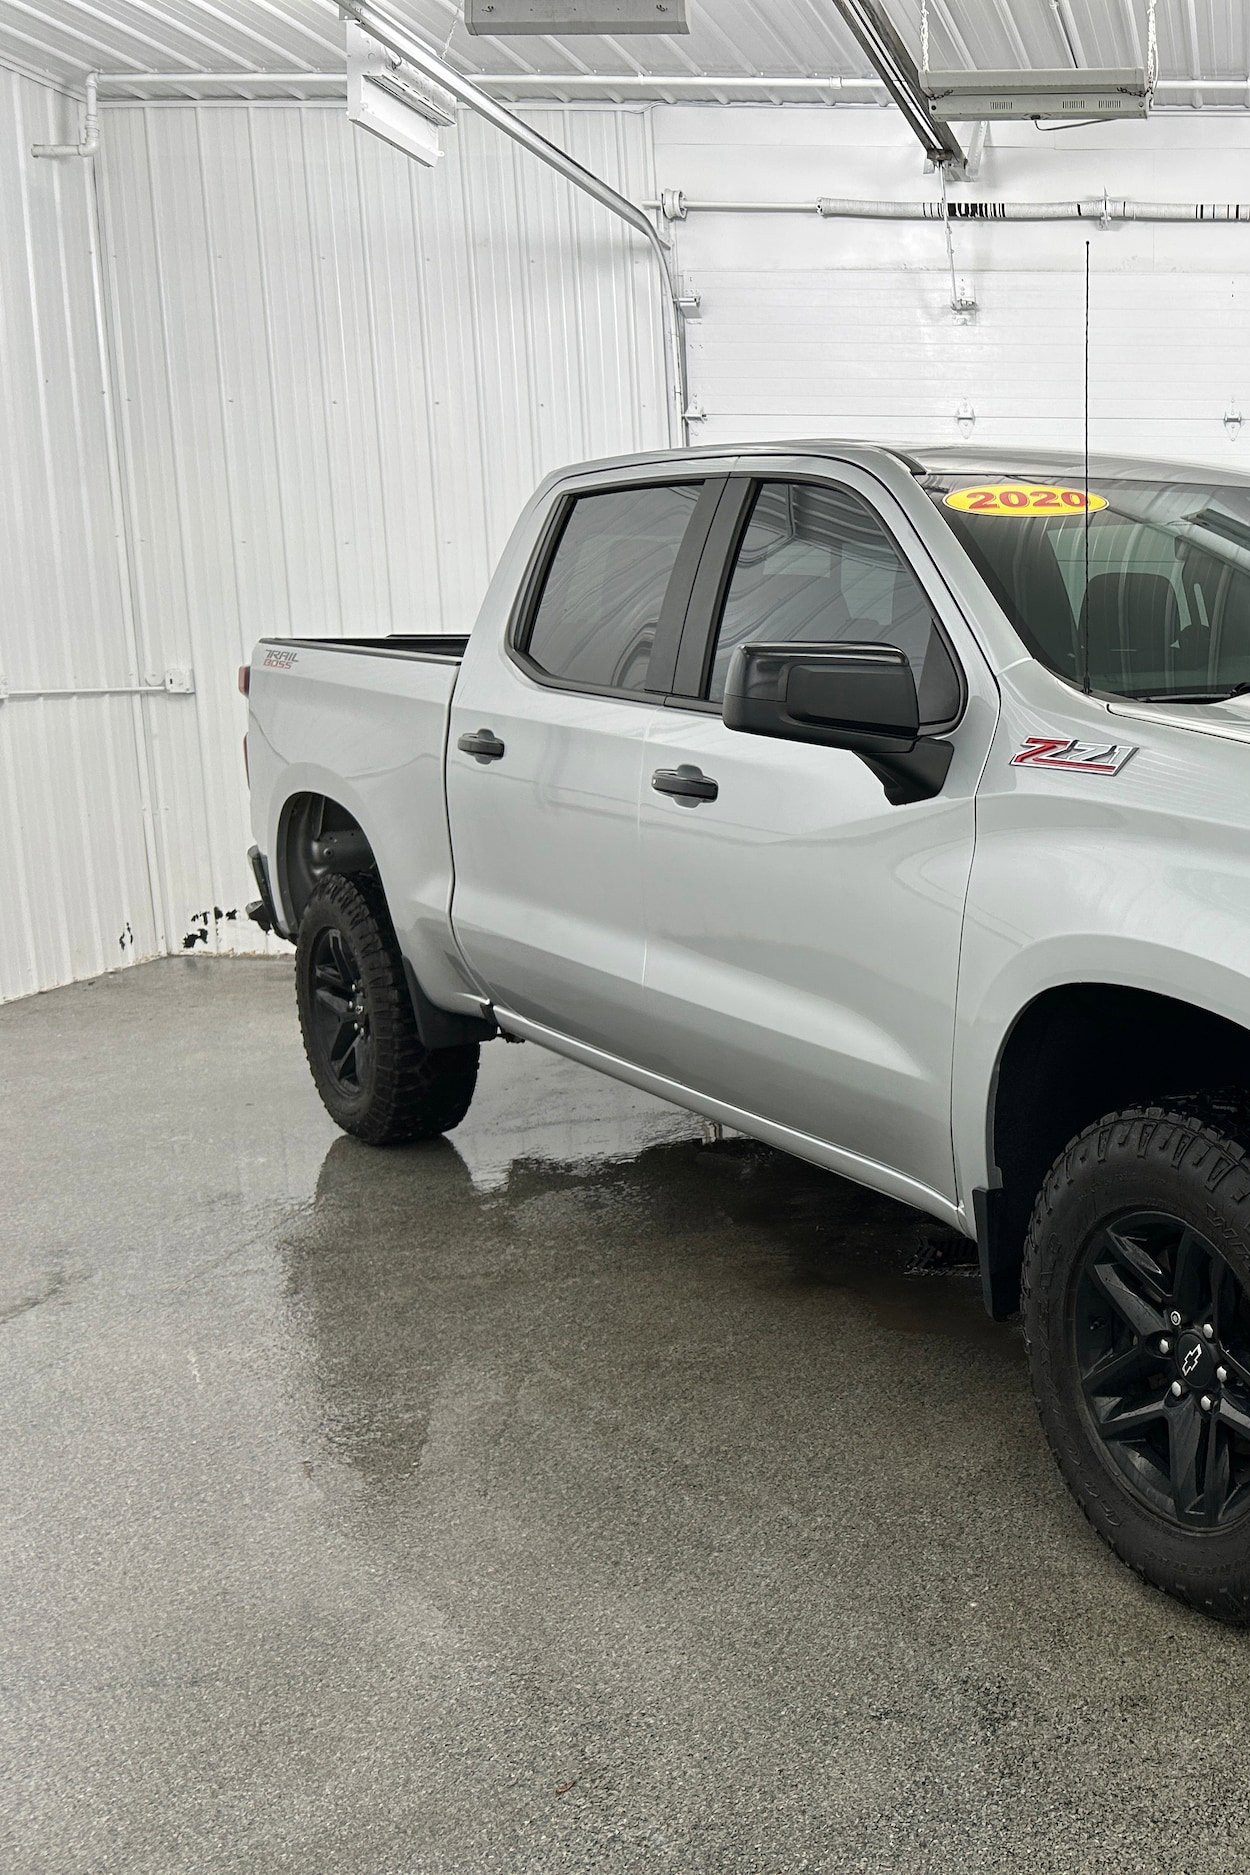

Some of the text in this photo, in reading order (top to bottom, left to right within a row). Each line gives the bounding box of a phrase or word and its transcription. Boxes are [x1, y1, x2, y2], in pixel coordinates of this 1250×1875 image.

[966, 491, 1091, 510] 2020
[266, 649, 298, 662] TRAIL
[264, 659, 292, 669] BOSS
[1010, 736, 1138, 776] Z71
